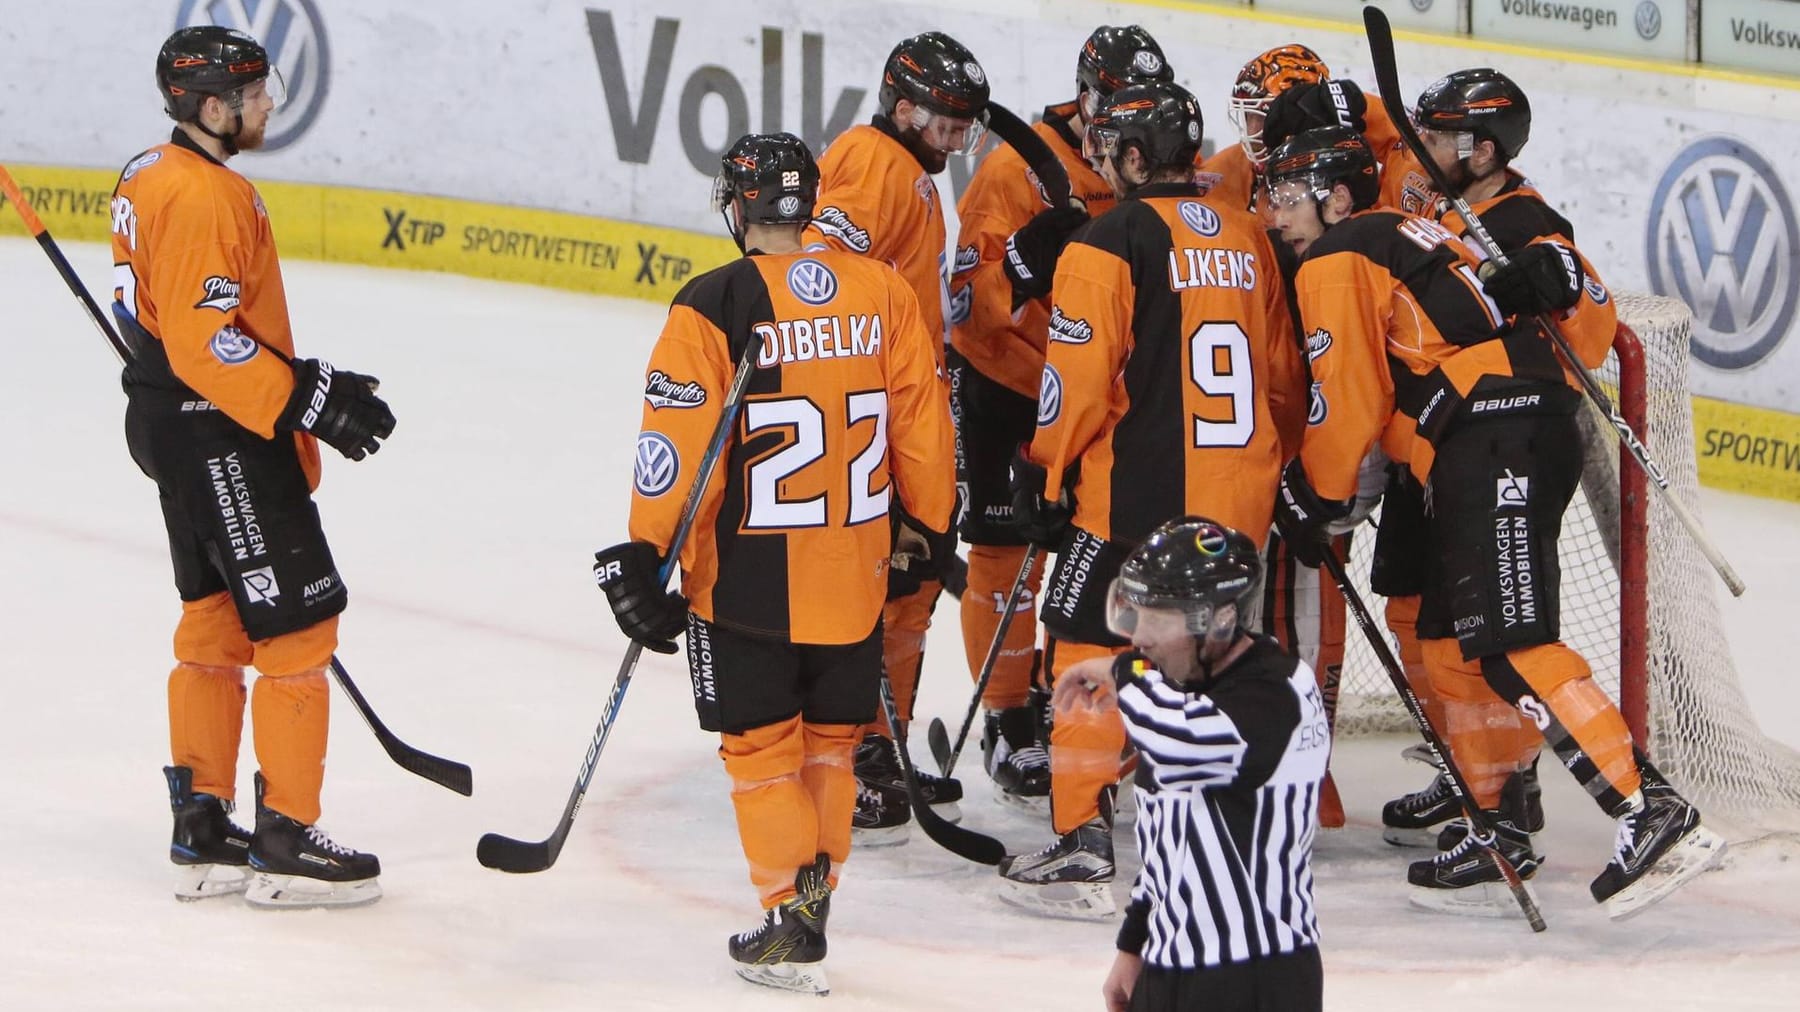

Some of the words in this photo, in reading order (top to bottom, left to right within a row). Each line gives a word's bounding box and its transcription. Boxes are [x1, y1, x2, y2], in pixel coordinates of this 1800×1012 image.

[1501, 0, 1617, 30] Volkswagen
[782, 171, 800, 188] 22
[461, 226, 620, 271] SPORTWETTEN
[1169, 248, 1256, 291] LIKENS
[754, 314, 882, 367] DIBELKA
[649, 372, 706, 402] Playoffs
[1192, 323, 1252, 446] 9
[1418, 388, 1446, 425] BAUER
[1471, 394, 1541, 413] BAUER
[744, 389, 891, 530] 22
[207, 457, 249, 561] IMMOBILIEN
[225, 452, 267, 556] VOLKSWAGEN
[1495, 517, 1518, 628] VOLKSWAGEN
[1513, 516, 1537, 623] IMMOBILIEN
